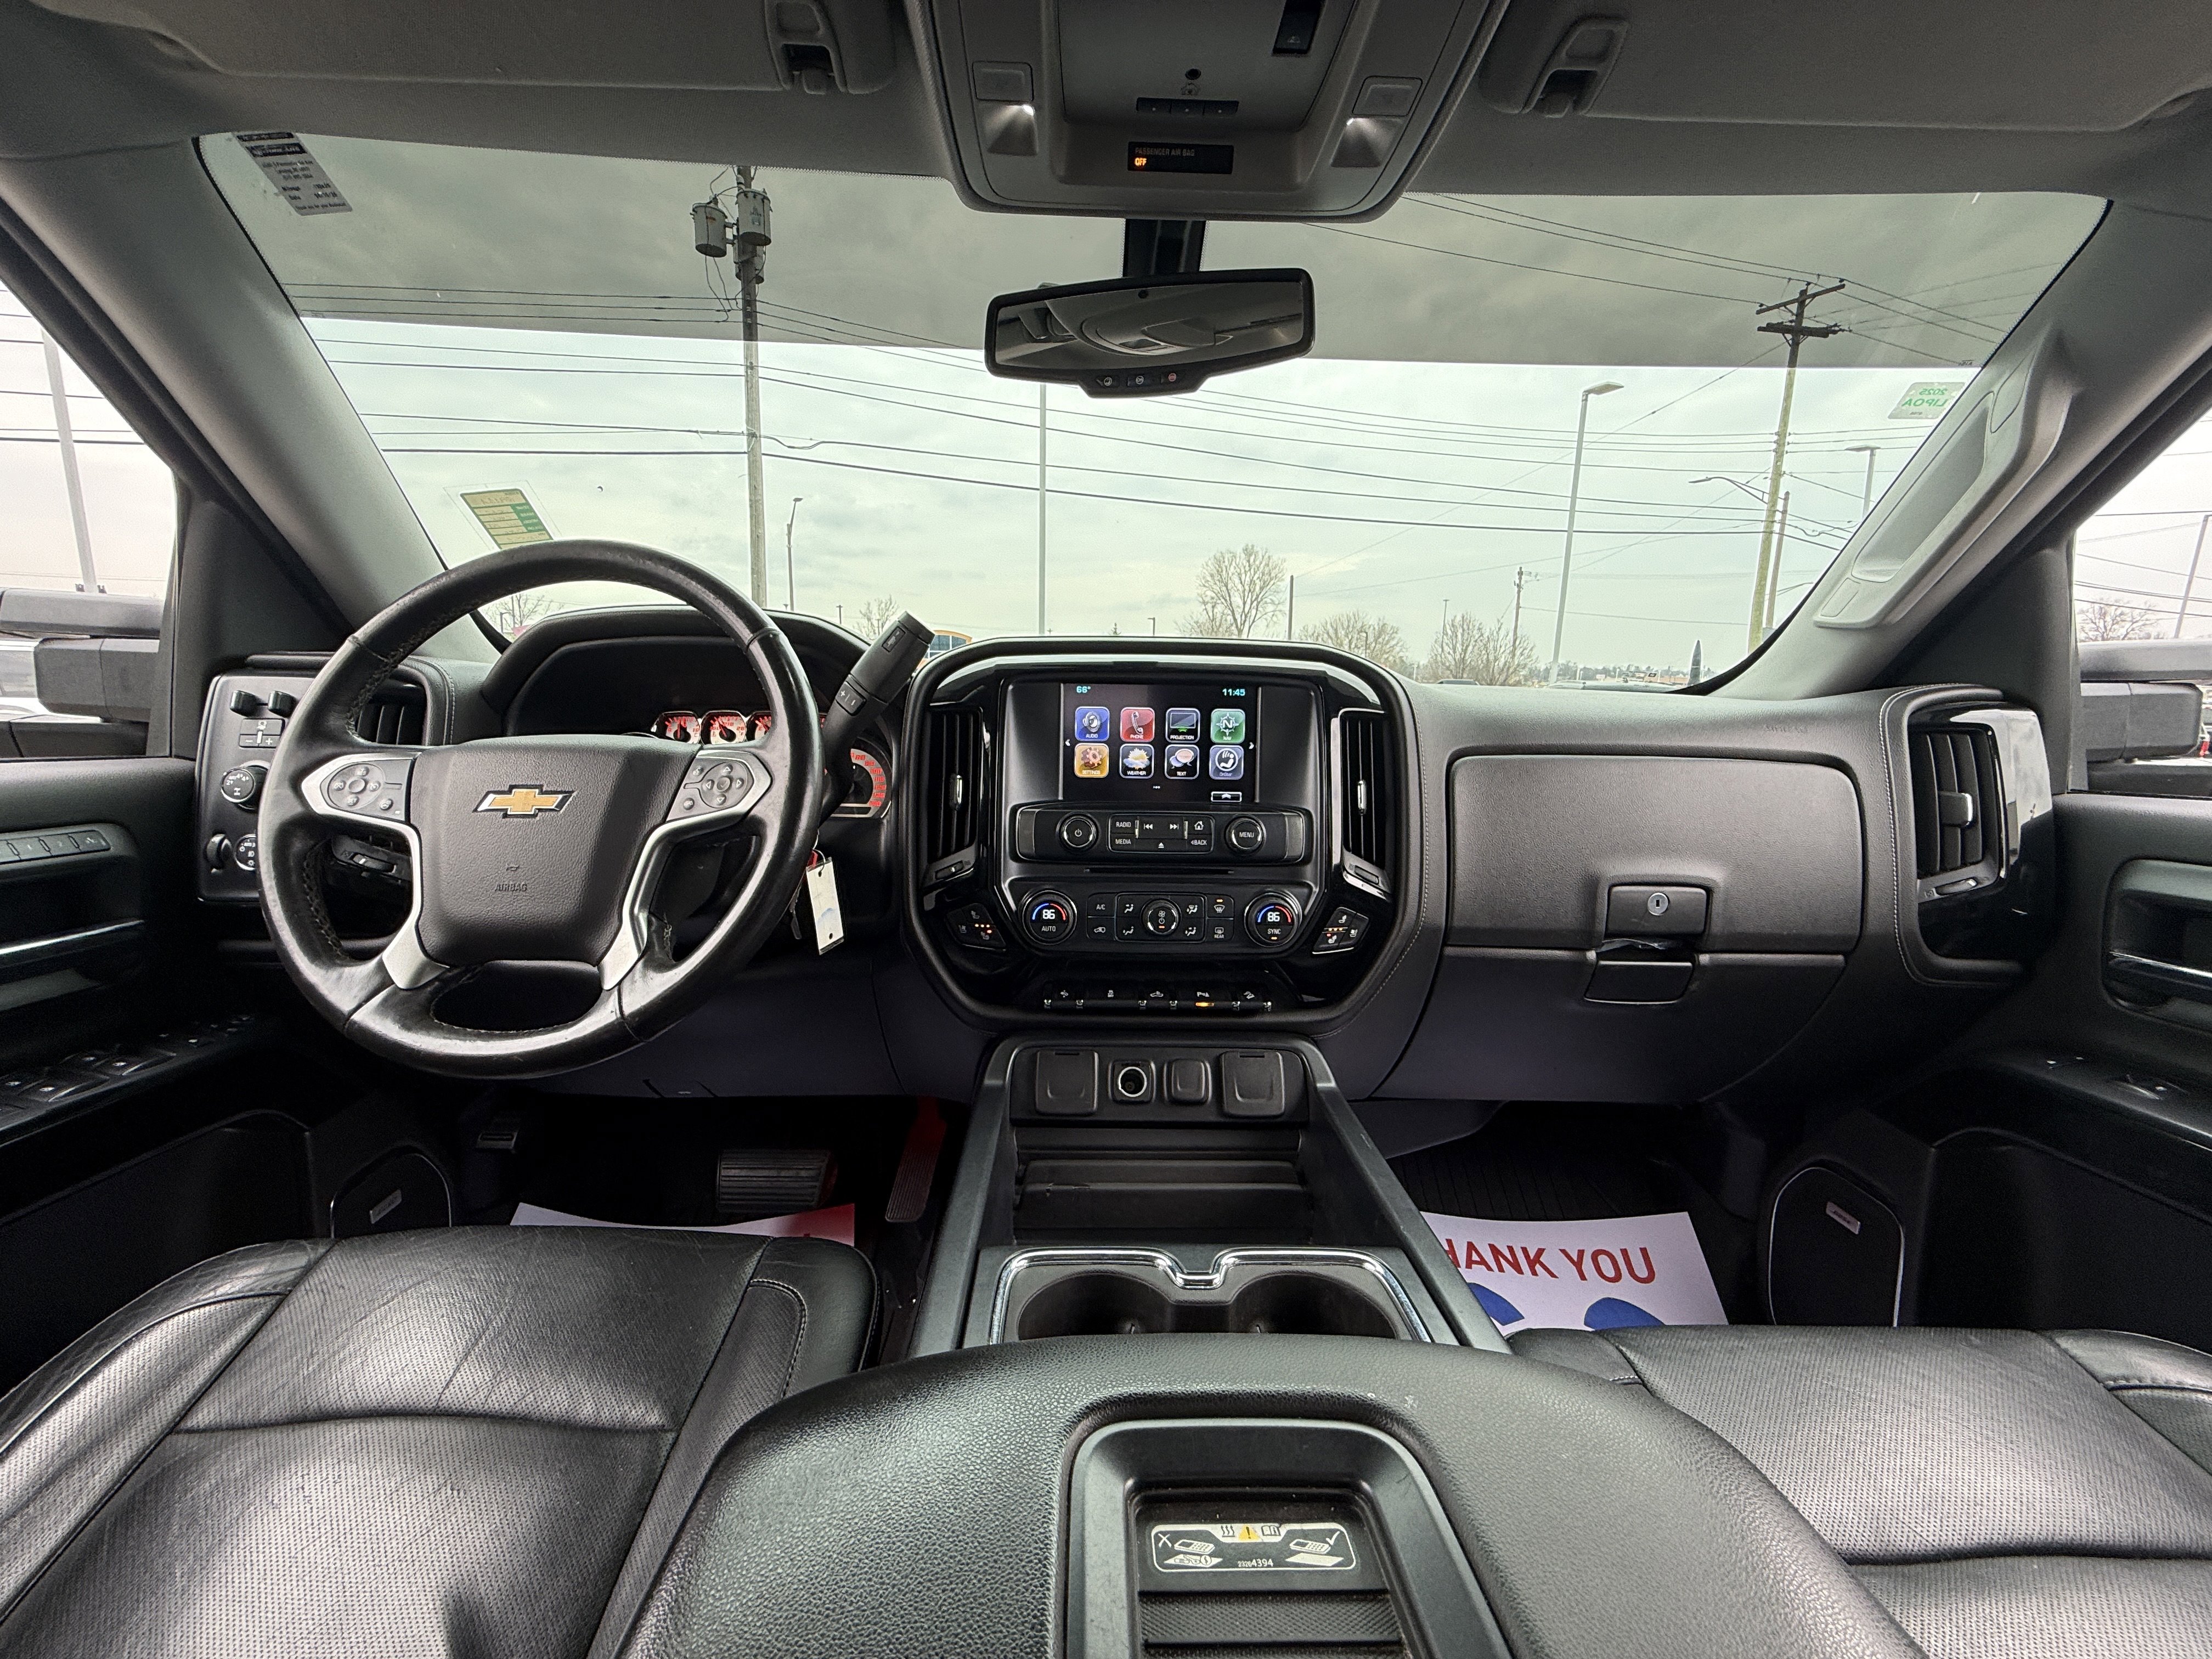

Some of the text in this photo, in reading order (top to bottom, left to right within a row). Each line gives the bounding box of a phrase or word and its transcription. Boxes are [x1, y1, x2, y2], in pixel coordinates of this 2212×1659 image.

[1135, 147, 1170, 156] PASSENGER
[1135, 157, 1147, 166] OFF
[1222, 688, 1245, 696] 11:45
[495, 883, 528, 892] AIRBAG
[1043, 909, 1056, 919] 86
[1267, 911, 1280, 922] 86
[1558, 1246, 1656, 1284] YOU
